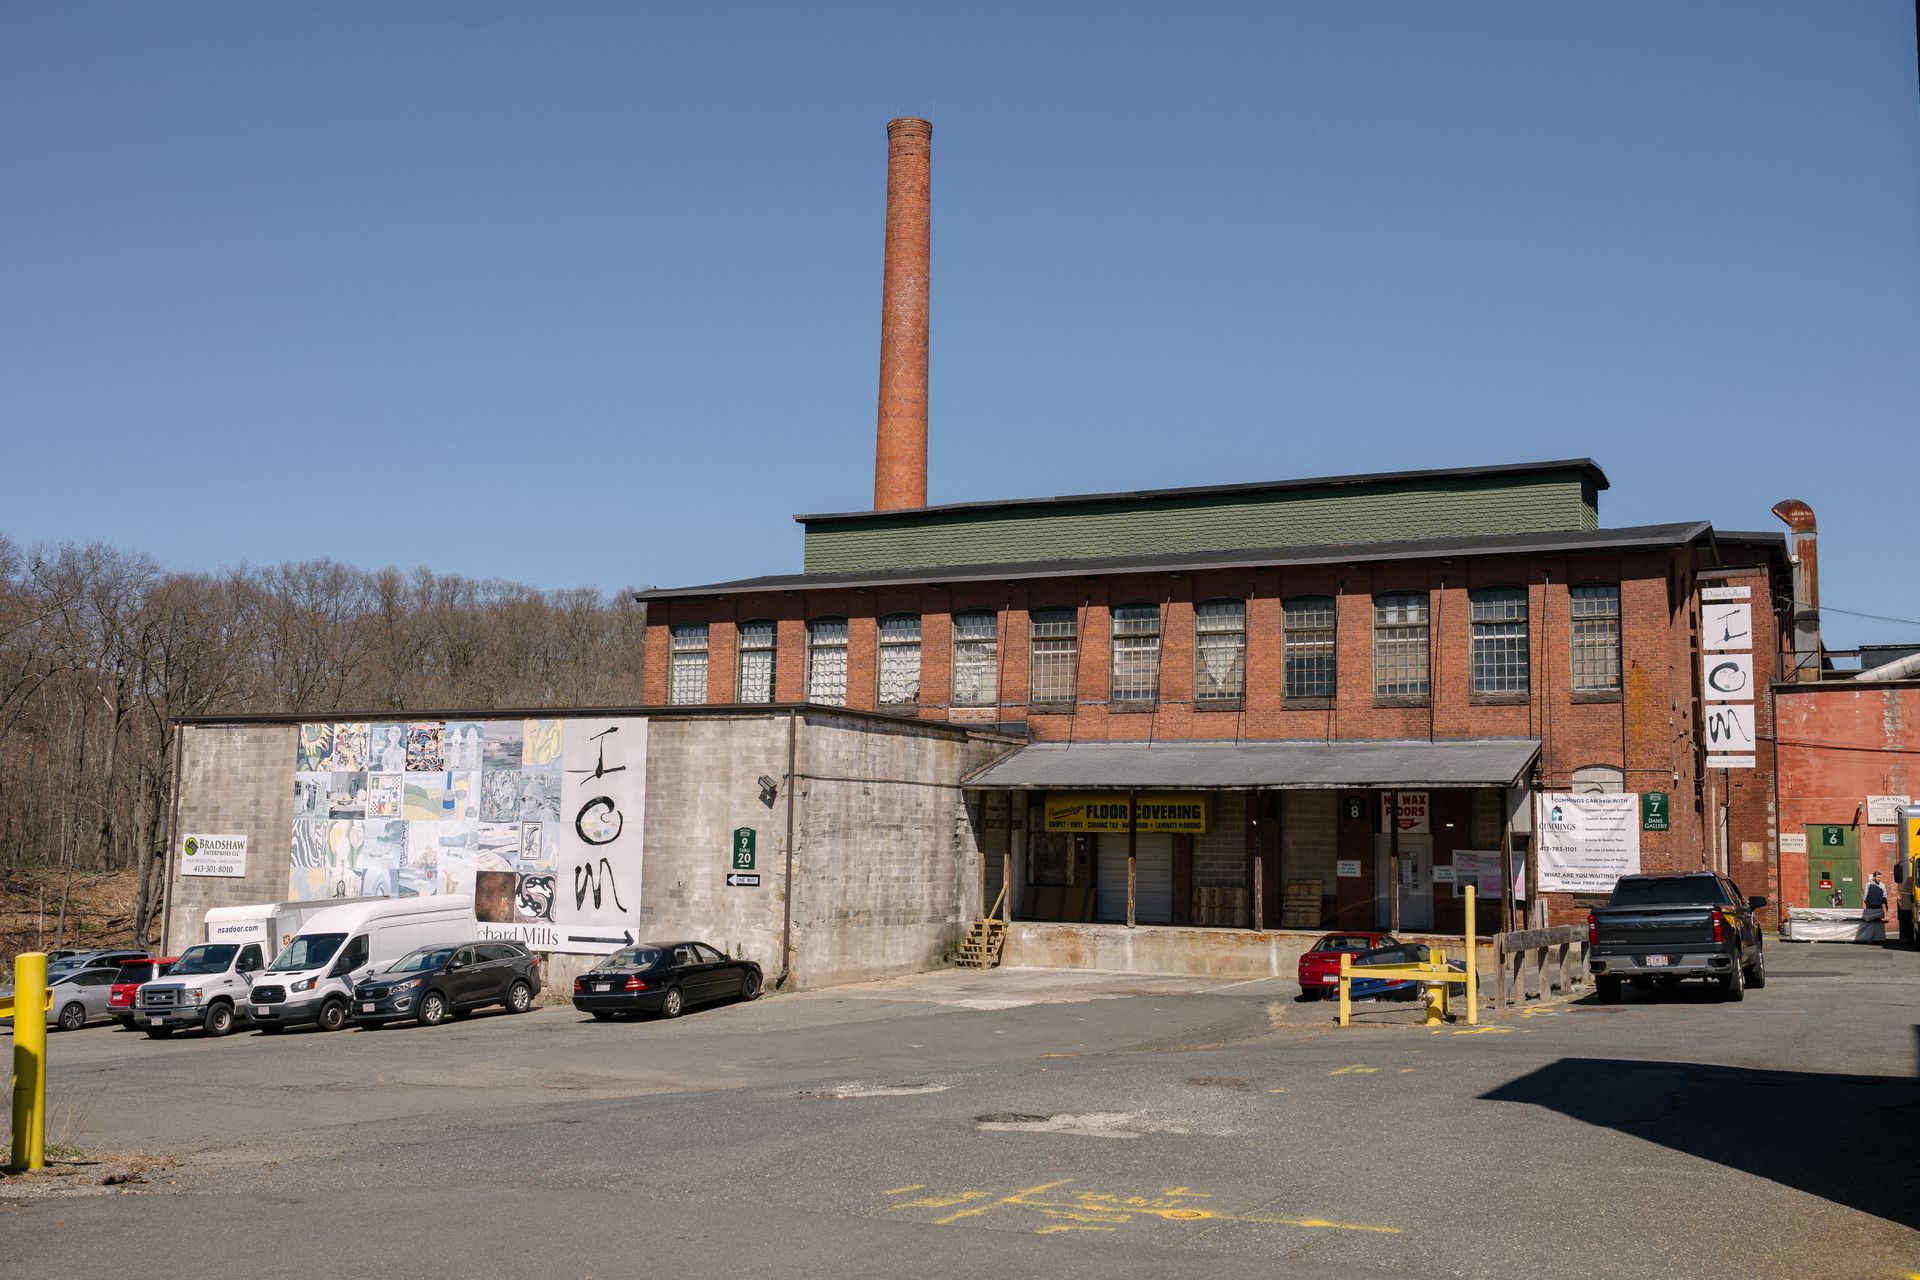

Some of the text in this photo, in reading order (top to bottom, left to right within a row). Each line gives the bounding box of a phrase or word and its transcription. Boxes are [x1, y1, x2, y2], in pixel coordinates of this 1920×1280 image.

[1402, 795, 1425, 805] WAX
[1086, 804, 1128, 819] FLOOR
[1135, 804, 1201, 819] COVERING
[1351, 805, 1359, 818] 8
[1385, 806, 1425, 816] FOORS
[1651, 802, 1660, 812] 7
[1539, 823, 1576, 831] CUMMINGS
[200, 838, 245, 850] BRADSHAW
[741, 837, 748, 848] 9
[1829, 834, 1838, 845] 6
[737, 853, 751, 863] 20
[193, 864, 234, 873] 413-301-8010
[217, 924, 259, 934] nsadoor.com
[522, 926, 559, 945] Mills
